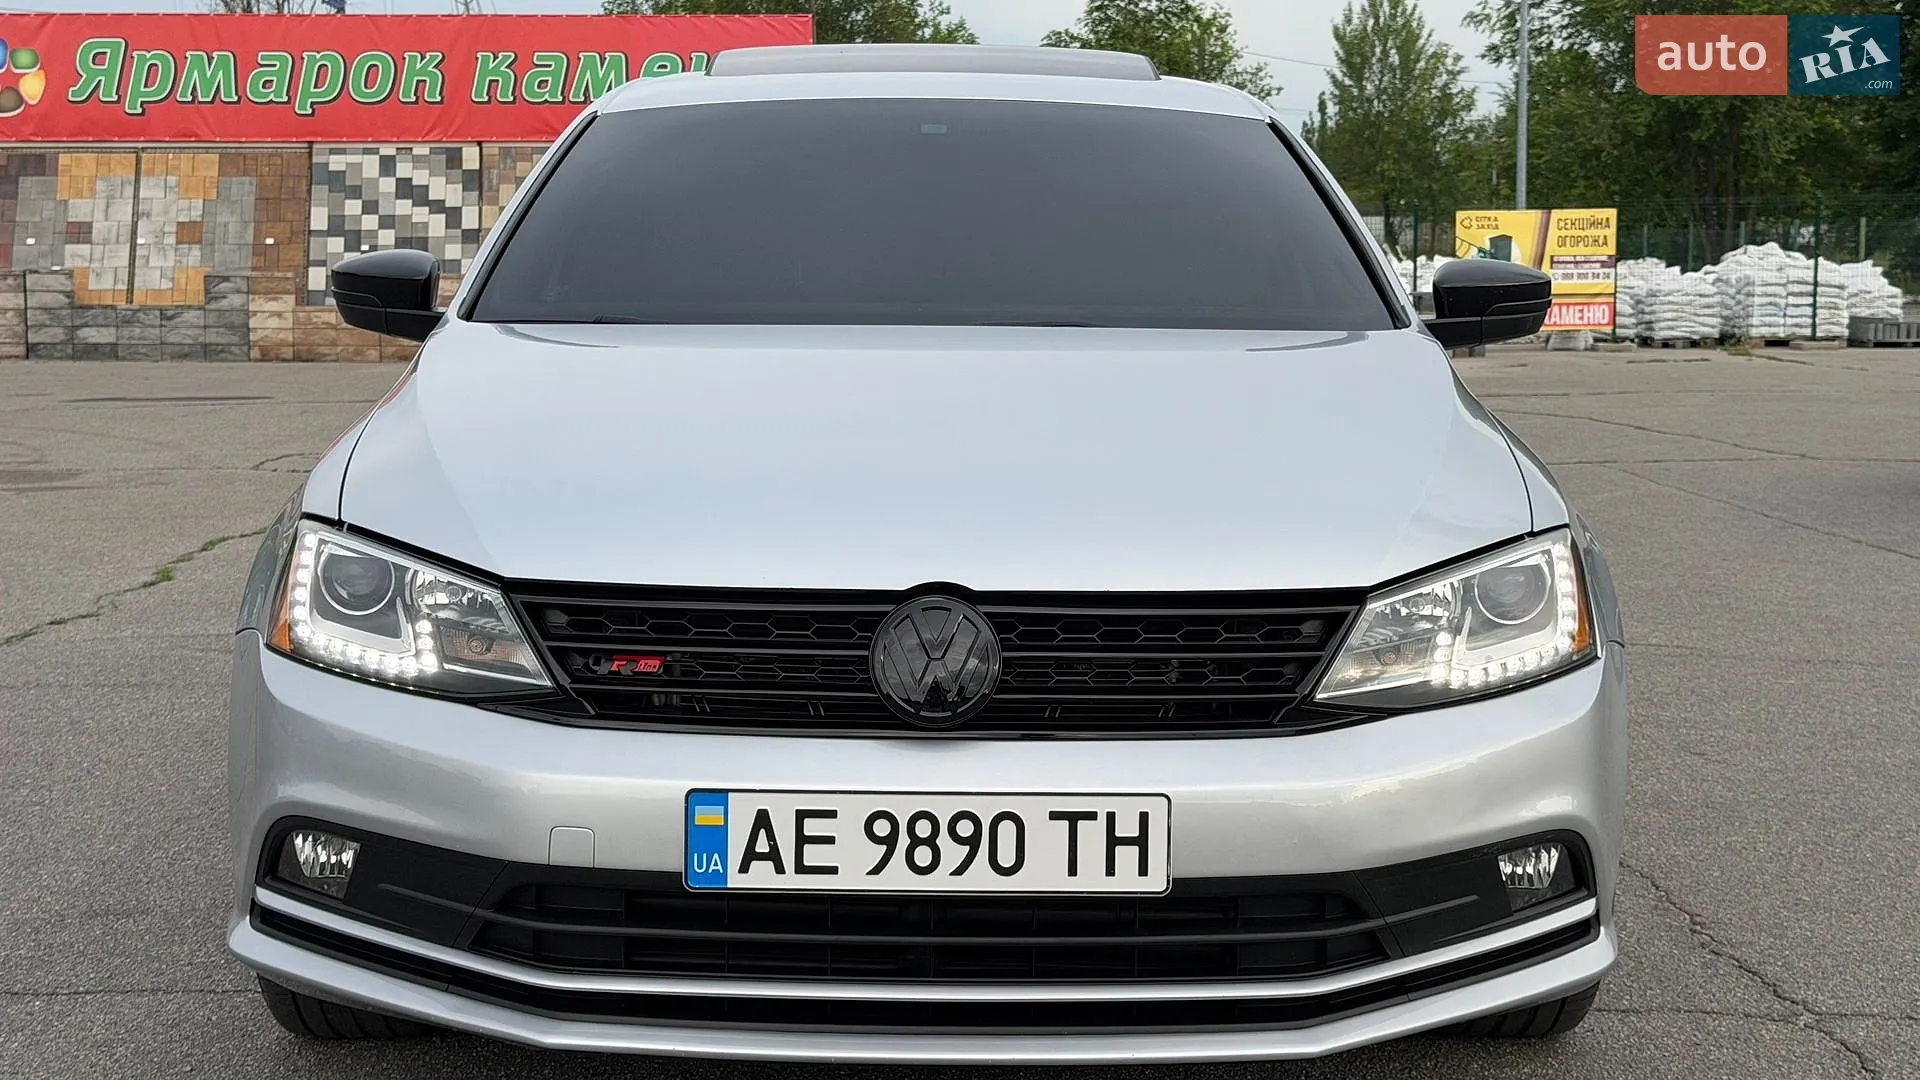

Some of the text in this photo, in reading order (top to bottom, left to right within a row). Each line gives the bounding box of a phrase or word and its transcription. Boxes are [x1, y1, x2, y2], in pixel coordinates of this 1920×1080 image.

[69, 37, 445, 115] Ярмарок
[1557, 214, 1610, 231] СЕКЦІЙНА
[1557, 234, 1608, 248] ОГОРОЖА
[738, 808, 1149, 877] AE 9890 TH
[693, 852, 724, 874] UA
